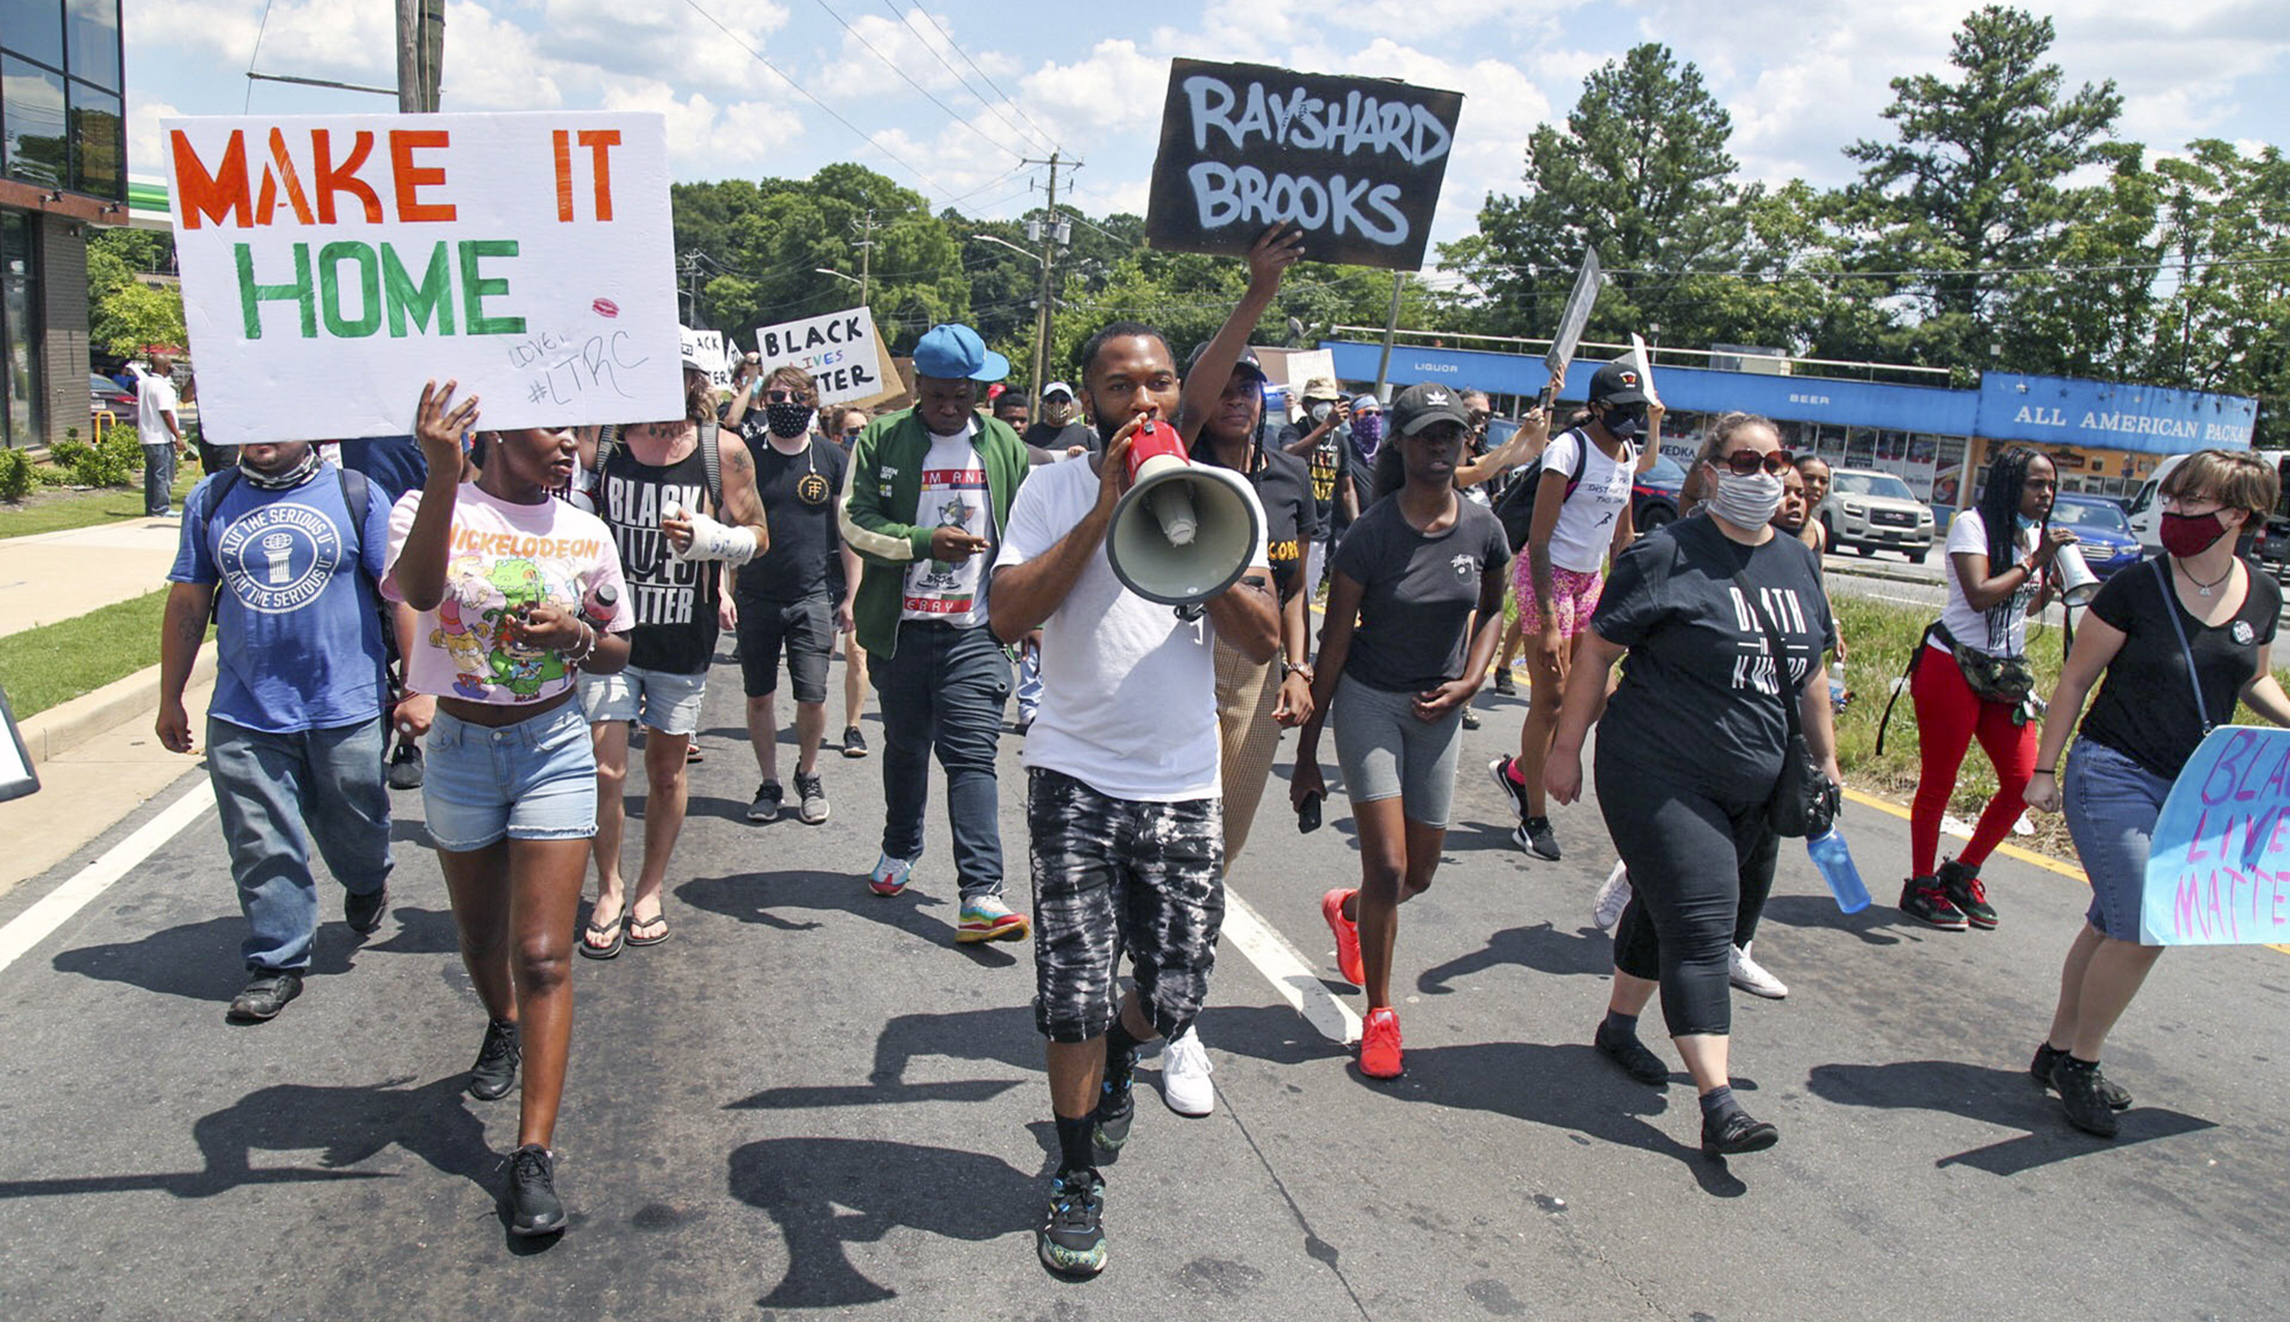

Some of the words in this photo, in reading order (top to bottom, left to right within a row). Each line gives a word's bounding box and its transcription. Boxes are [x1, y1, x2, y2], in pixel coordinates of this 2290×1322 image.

[1183, 76, 1451, 166] RAYSHARD
[170, 127, 457, 230] MAKE
[552, 129, 622, 222] IT
[1188, 161, 1410, 246] BROOKS
[234, 239, 527, 340] HOME
[764, 316, 863, 357] BLACK
[528, 330, 650, 406] #LTRC
[789, 350, 844, 370] IVES
[813, 365, 875, 393] TER
[1414, 362, 1459, 374] LIQUOR
[1789, 393, 1830, 405] BEER
[2014, 406, 2067, 427] ALL
[2080, 411, 2199, 438] AMERICAN
[239, 511, 269, 534] THE
[269, 508, 328, 536] SERIOUS
[246, 586, 272, 607] THE
[273, 568, 327, 608] SERIOUS
[2201, 728, 2290, 806] BLA
[2174, 863, 2290, 944] MATTE
